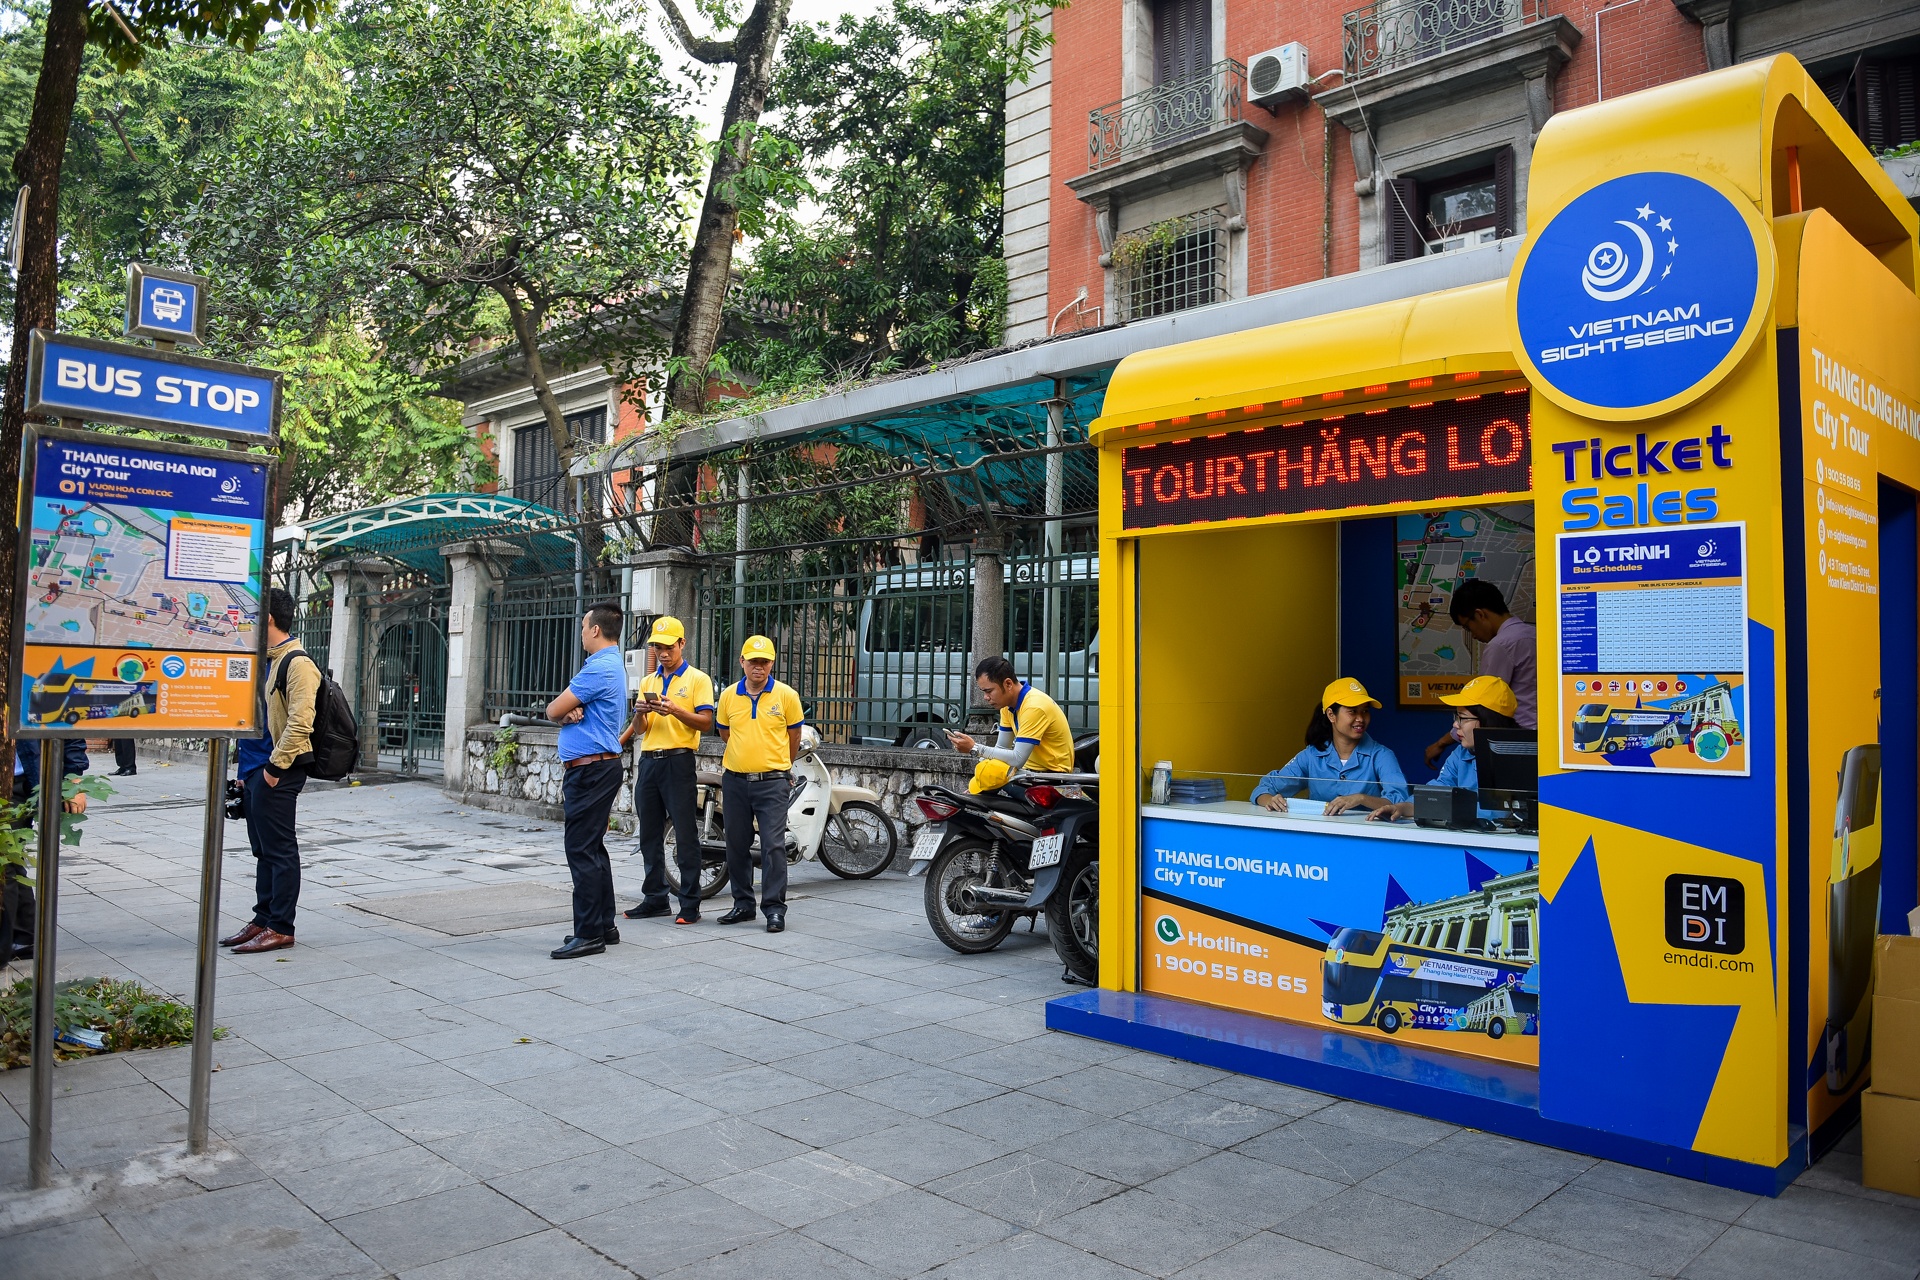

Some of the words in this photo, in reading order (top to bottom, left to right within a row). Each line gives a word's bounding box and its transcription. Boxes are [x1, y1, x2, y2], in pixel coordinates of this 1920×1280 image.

[1568, 302, 1700, 339] VIETNAM
[1541, 317, 1734, 364] SIGHTSEEING
[57, 358, 142, 398] BUS
[156, 376, 260, 414] STOP
[1812, 347, 1859, 407] THANG
[1861, 378, 1892, 427] LONG
[1893, 398, 1908, 435] HA
[1812, 399, 1838, 450] City
[1840, 412, 1870, 457] Tour
[62, 450, 119, 466] THANG
[122, 458, 164, 472] LONG
[166, 463, 188, 474] HA
[190, 466, 217, 478] NOI
[1552, 424, 1734, 483] Ticket
[61, 464, 91, 478] City
[94, 467, 131, 480] Tour
[1561, 482, 1718, 530] Sales
[1573, 546, 1600, 566] LỘ
[1604, 543, 1670, 562] TRÌNH
[1573, 565, 1592, 574] Bus
[1593, 563, 1643, 573] Schedules
[189, 668, 217, 678] WIFI
[190, 658, 222, 667] FREE
[1032, 850, 1059, 867] 605.78
[1154, 848, 1213, 869] THANG
[1215, 854, 1263, 875] LONG
[1265, 859, 1293, 878] HA
[1295, 863, 1329, 882] NOI
[1154, 868, 1184, 886] City
[1187, 870, 1225, 888] Tour
[1681, 882, 1727, 913] EM
[1188, 930, 1269, 959] Hotline:
[1154, 953, 1162, 968] 1
[1165, 958, 1207, 976] 900
[1210, 963, 1238, 982] 55
[1242, 968, 1274, 987] 88
[1277, 973, 1308, 994] 65
[1420, 959, 1453, 970] VIETNAM
[1454, 965, 1495, 978] SIGHTSEEING
[1663, 951, 1754, 973] emddi.com
[1420, 1004, 1437, 1014] City
[1438, 1006, 1458, 1014] Tour
